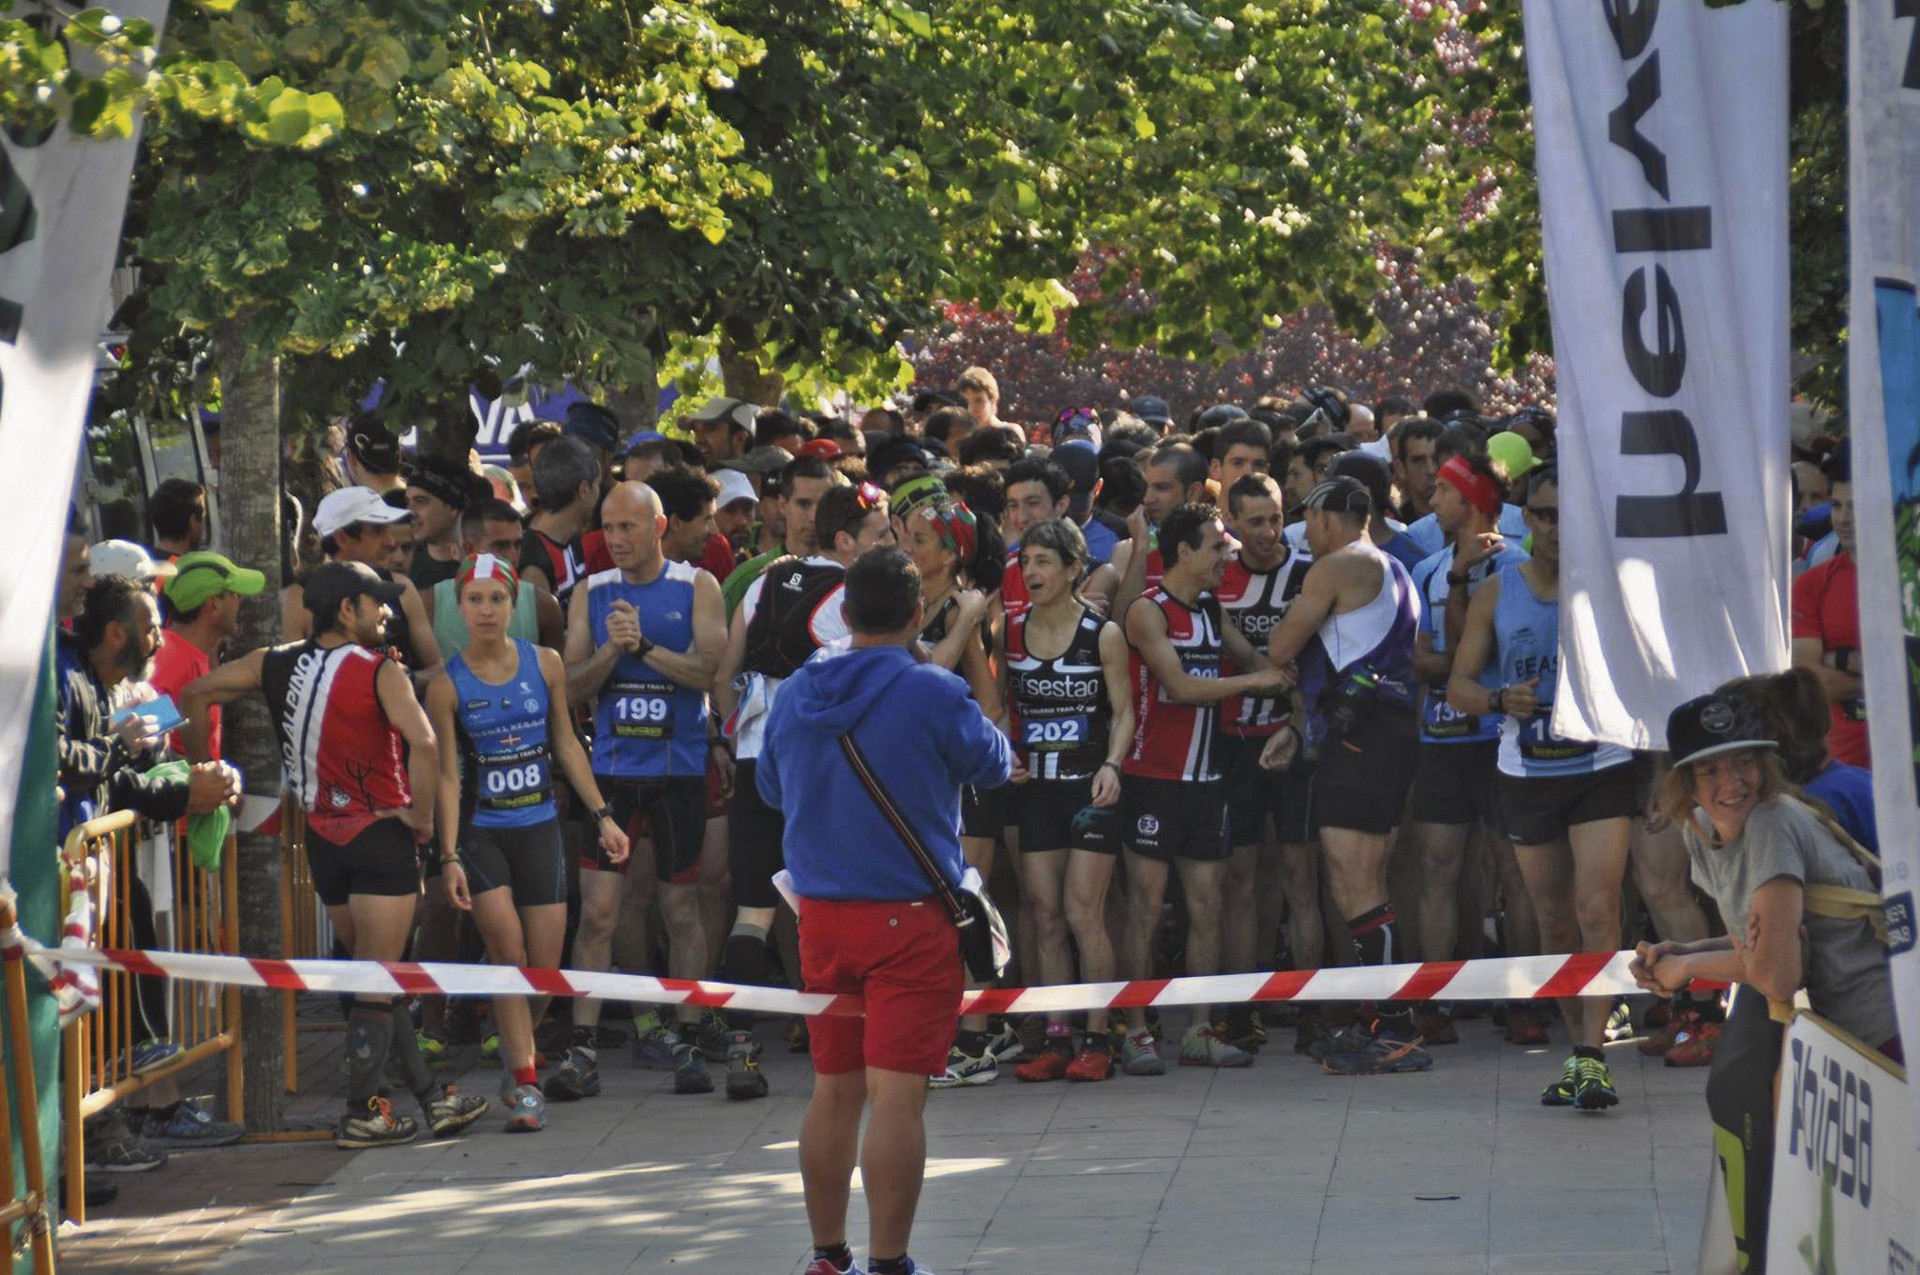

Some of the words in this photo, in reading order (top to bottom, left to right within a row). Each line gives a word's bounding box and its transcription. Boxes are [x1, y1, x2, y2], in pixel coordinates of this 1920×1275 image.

[281, 652, 311, 737] ALPINO
[615, 697, 667, 720] 199
[1433, 701, 1467, 722] 13
[1027, 720, 1080, 743] 202
[487, 764, 541, 793] 008
